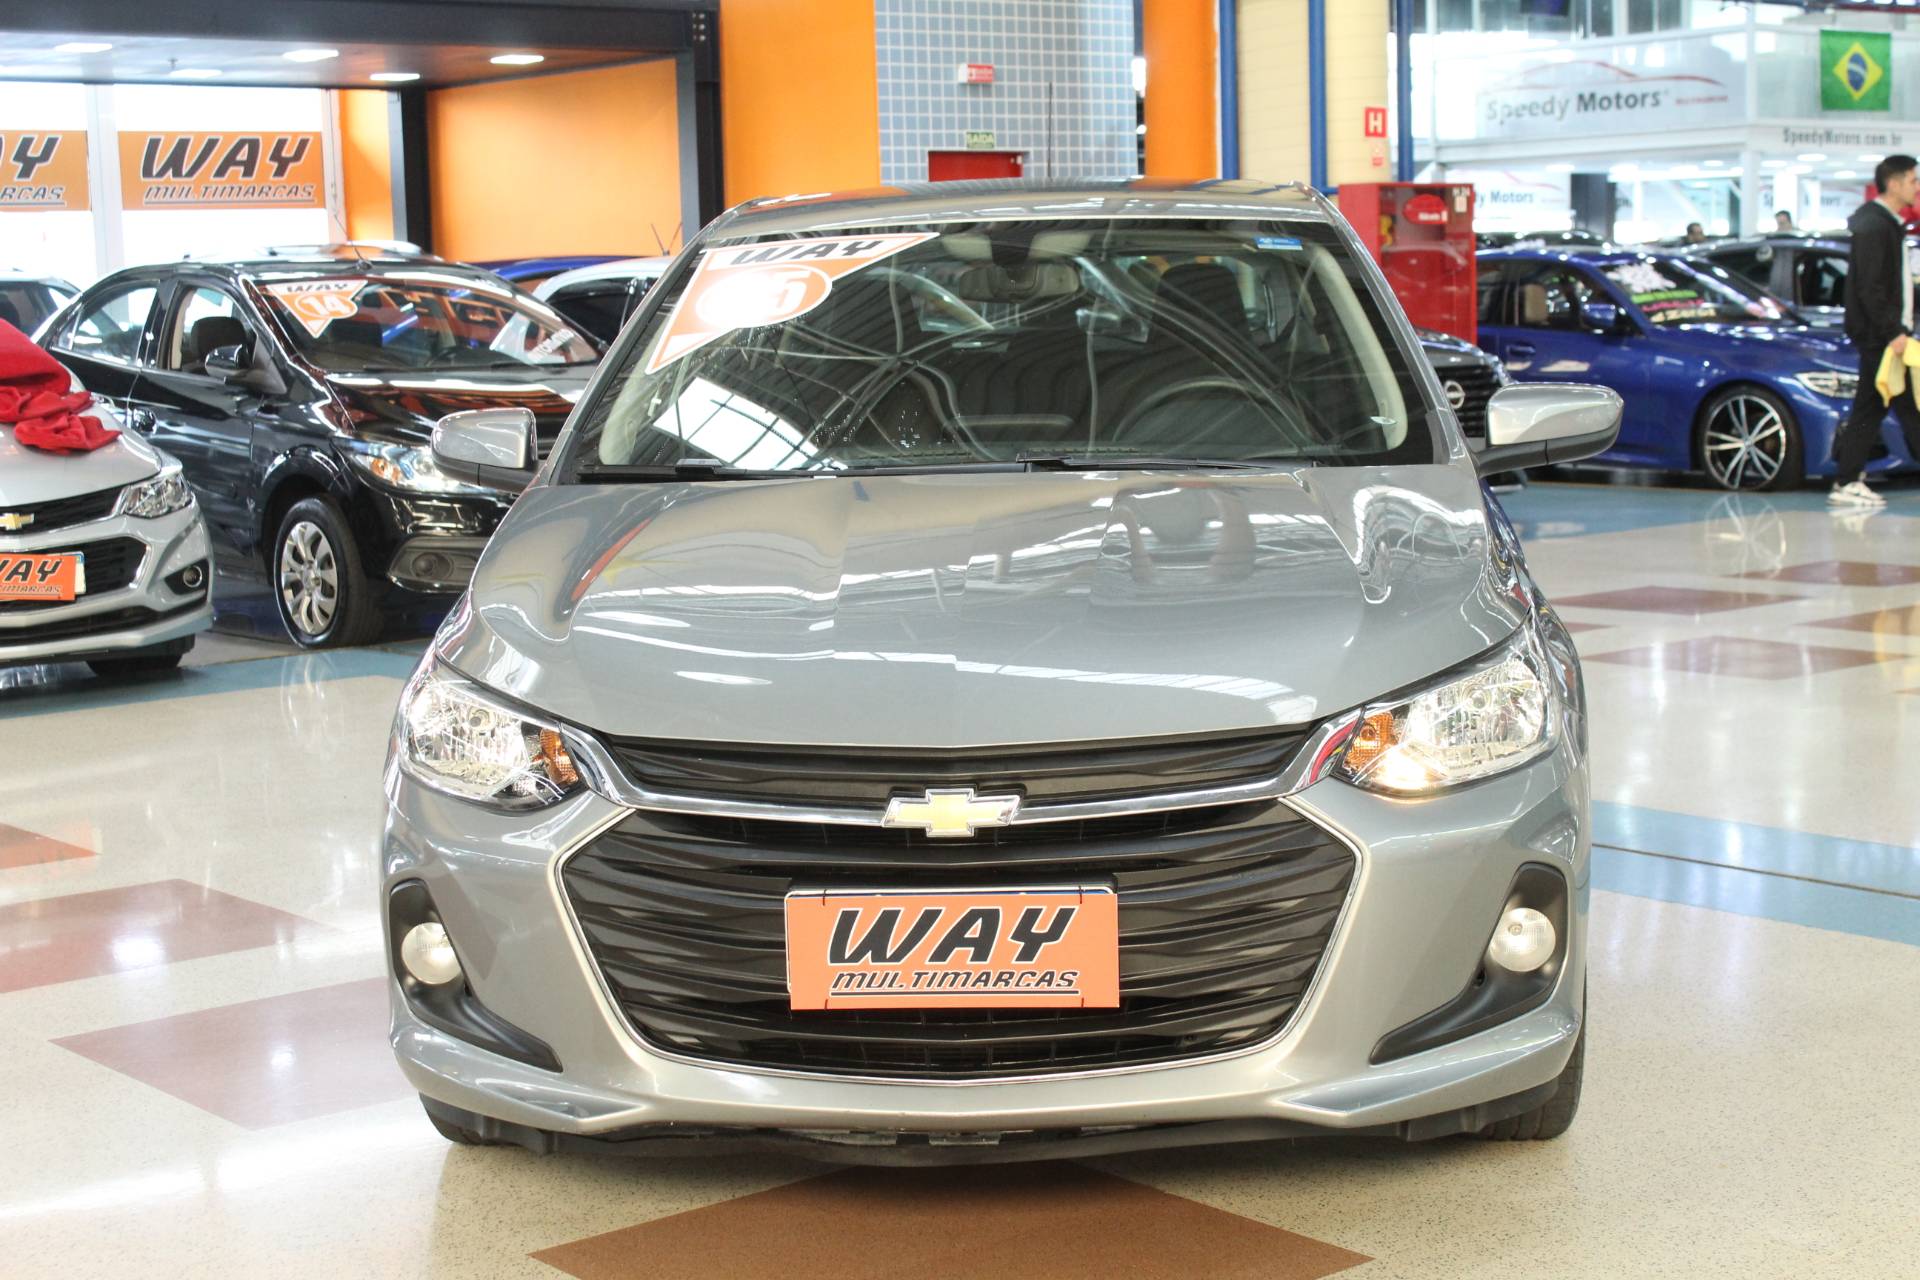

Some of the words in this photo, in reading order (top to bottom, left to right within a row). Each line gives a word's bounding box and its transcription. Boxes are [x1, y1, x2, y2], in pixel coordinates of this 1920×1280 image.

[1486, 96, 1570, 125] Speedy
[1576, 90, 1661, 113] Motors
[1368, 111, 1383, 134] H
[140, 136, 312, 181] WAY
[144, 184, 316, 200] MULTIMARCAS
[730, 240, 885, 266] WAY
[300, 295, 352, 316] 14
[827, 905, 1081, 966] WAY
[830, 969, 1081, 991] MULTIMARCAS
